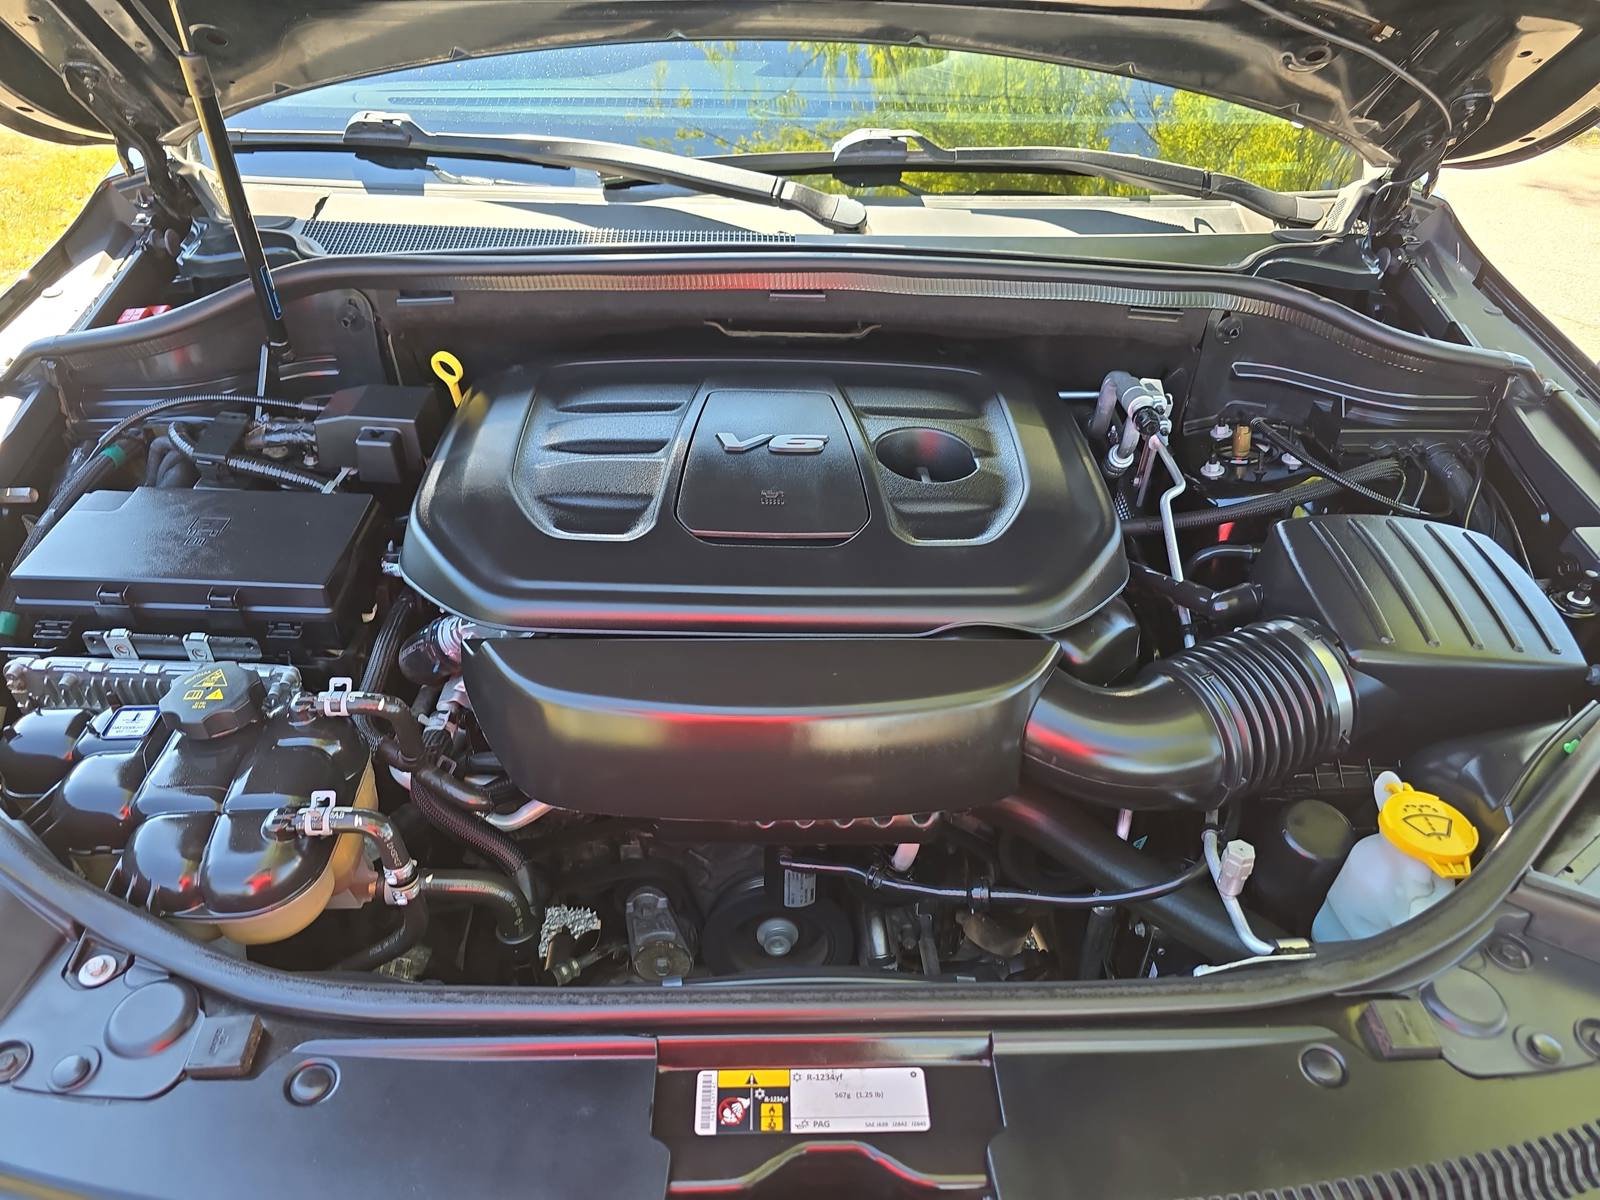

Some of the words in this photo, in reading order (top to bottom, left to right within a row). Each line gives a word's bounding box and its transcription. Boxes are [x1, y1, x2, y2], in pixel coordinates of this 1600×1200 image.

[715, 432, 830, 454] V6
[806, 1073, 843, 1082] R-1234yf
[834, 1091, 851, 1100] 567g
[813, 1119, 831, 1128] PAG
